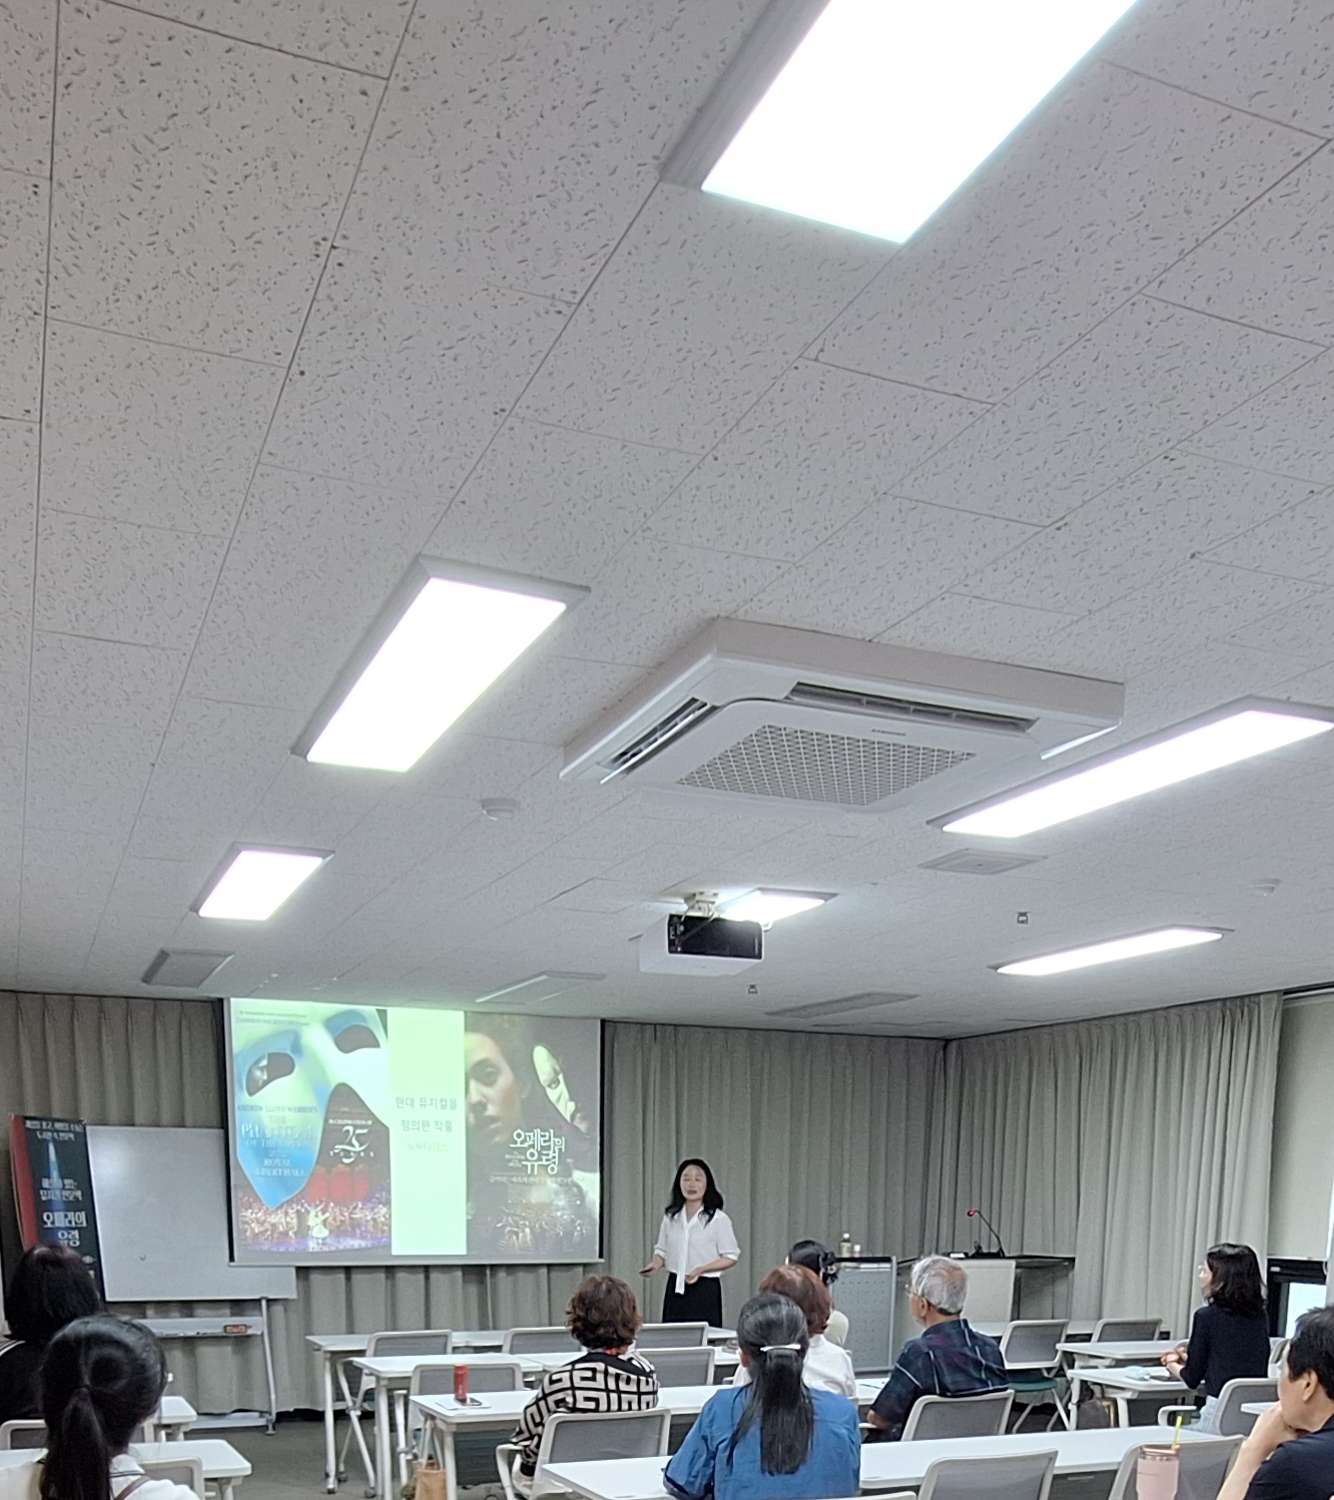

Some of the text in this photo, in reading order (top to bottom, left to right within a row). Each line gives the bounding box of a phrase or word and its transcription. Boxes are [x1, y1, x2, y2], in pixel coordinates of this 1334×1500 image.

[395, 1096, 457, 1110] 현대 뮤지컬을
[400, 1119, 453, 1133] 정의한 작품
[333, 1125, 371, 1164] 25
[509, 1127, 565, 1153] 오페라의
[521, 1147, 559, 1176] 유령
